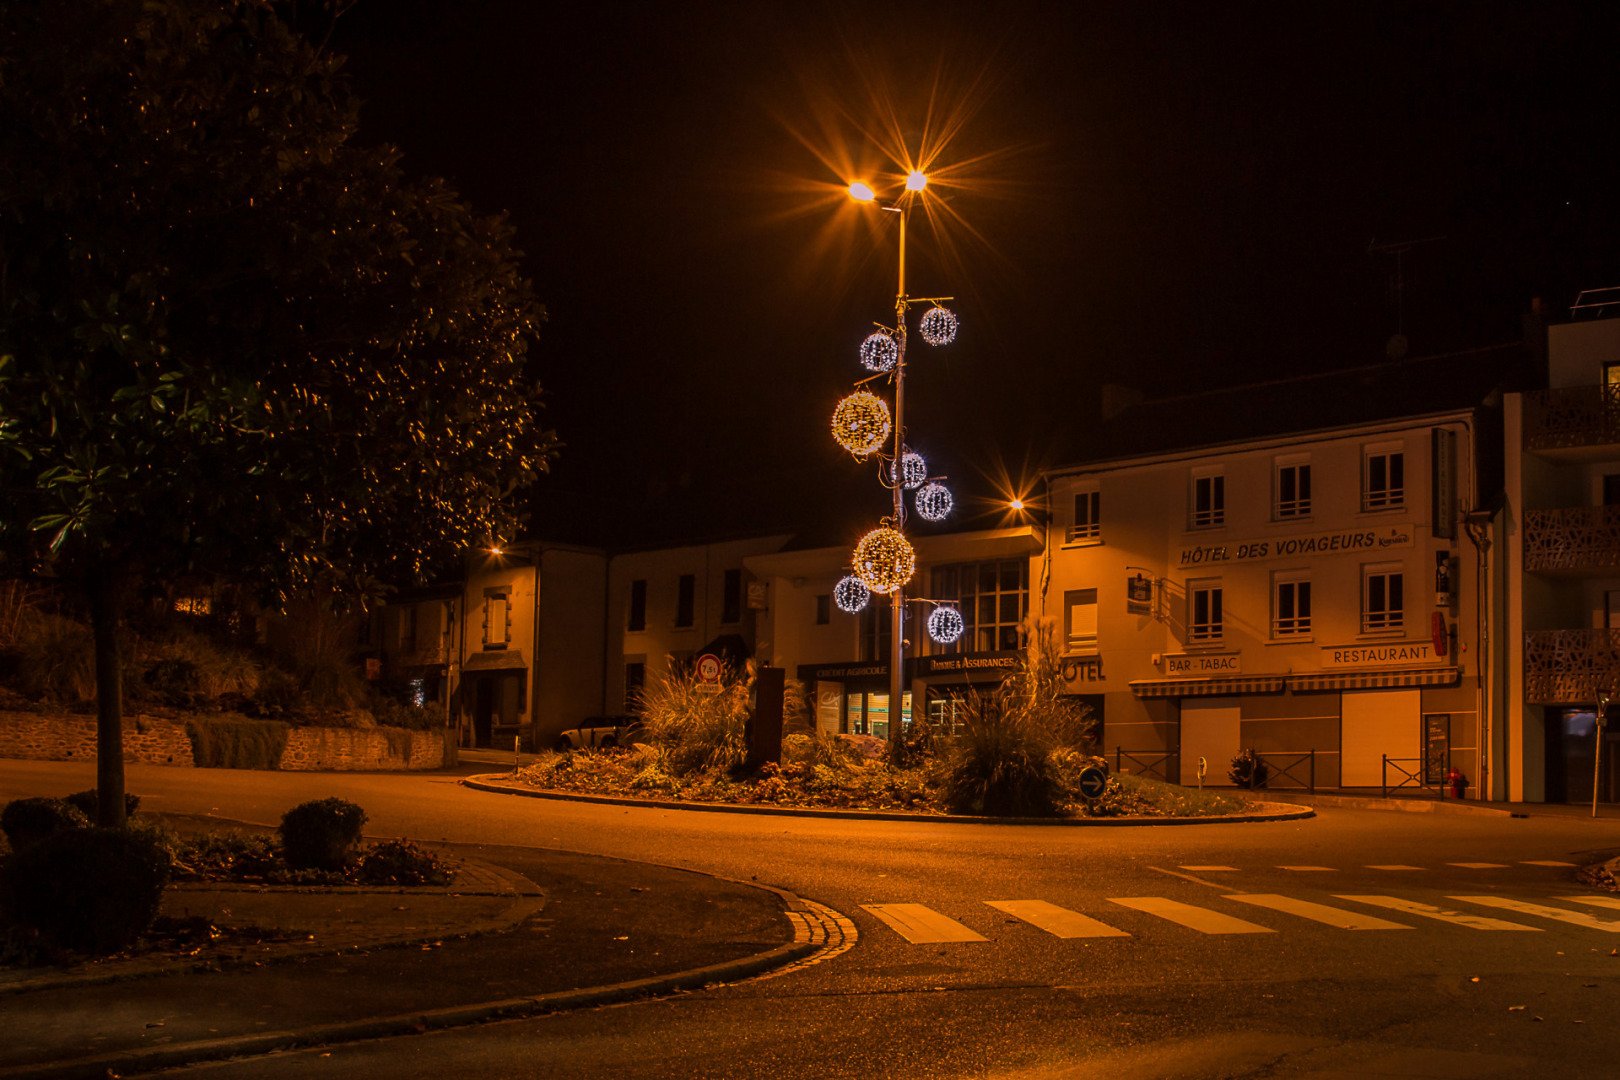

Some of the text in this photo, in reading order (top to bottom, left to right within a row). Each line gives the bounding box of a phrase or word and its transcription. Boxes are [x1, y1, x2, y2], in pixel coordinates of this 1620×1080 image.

[1181, 547, 1231, 564] HÔTEL
[1237, 543, 1268, 560] DES
[1276, 532, 1376, 555] VOYAGEURS
[1334, 646, 1429, 663] RESTAURANT
[962, 657, 1014, 668] ASSURANCES
[1169, 660, 1191, 672] BAR
[1200, 657, 1237, 670] TABAC
[846, 665, 888, 676] AGRICOLE
